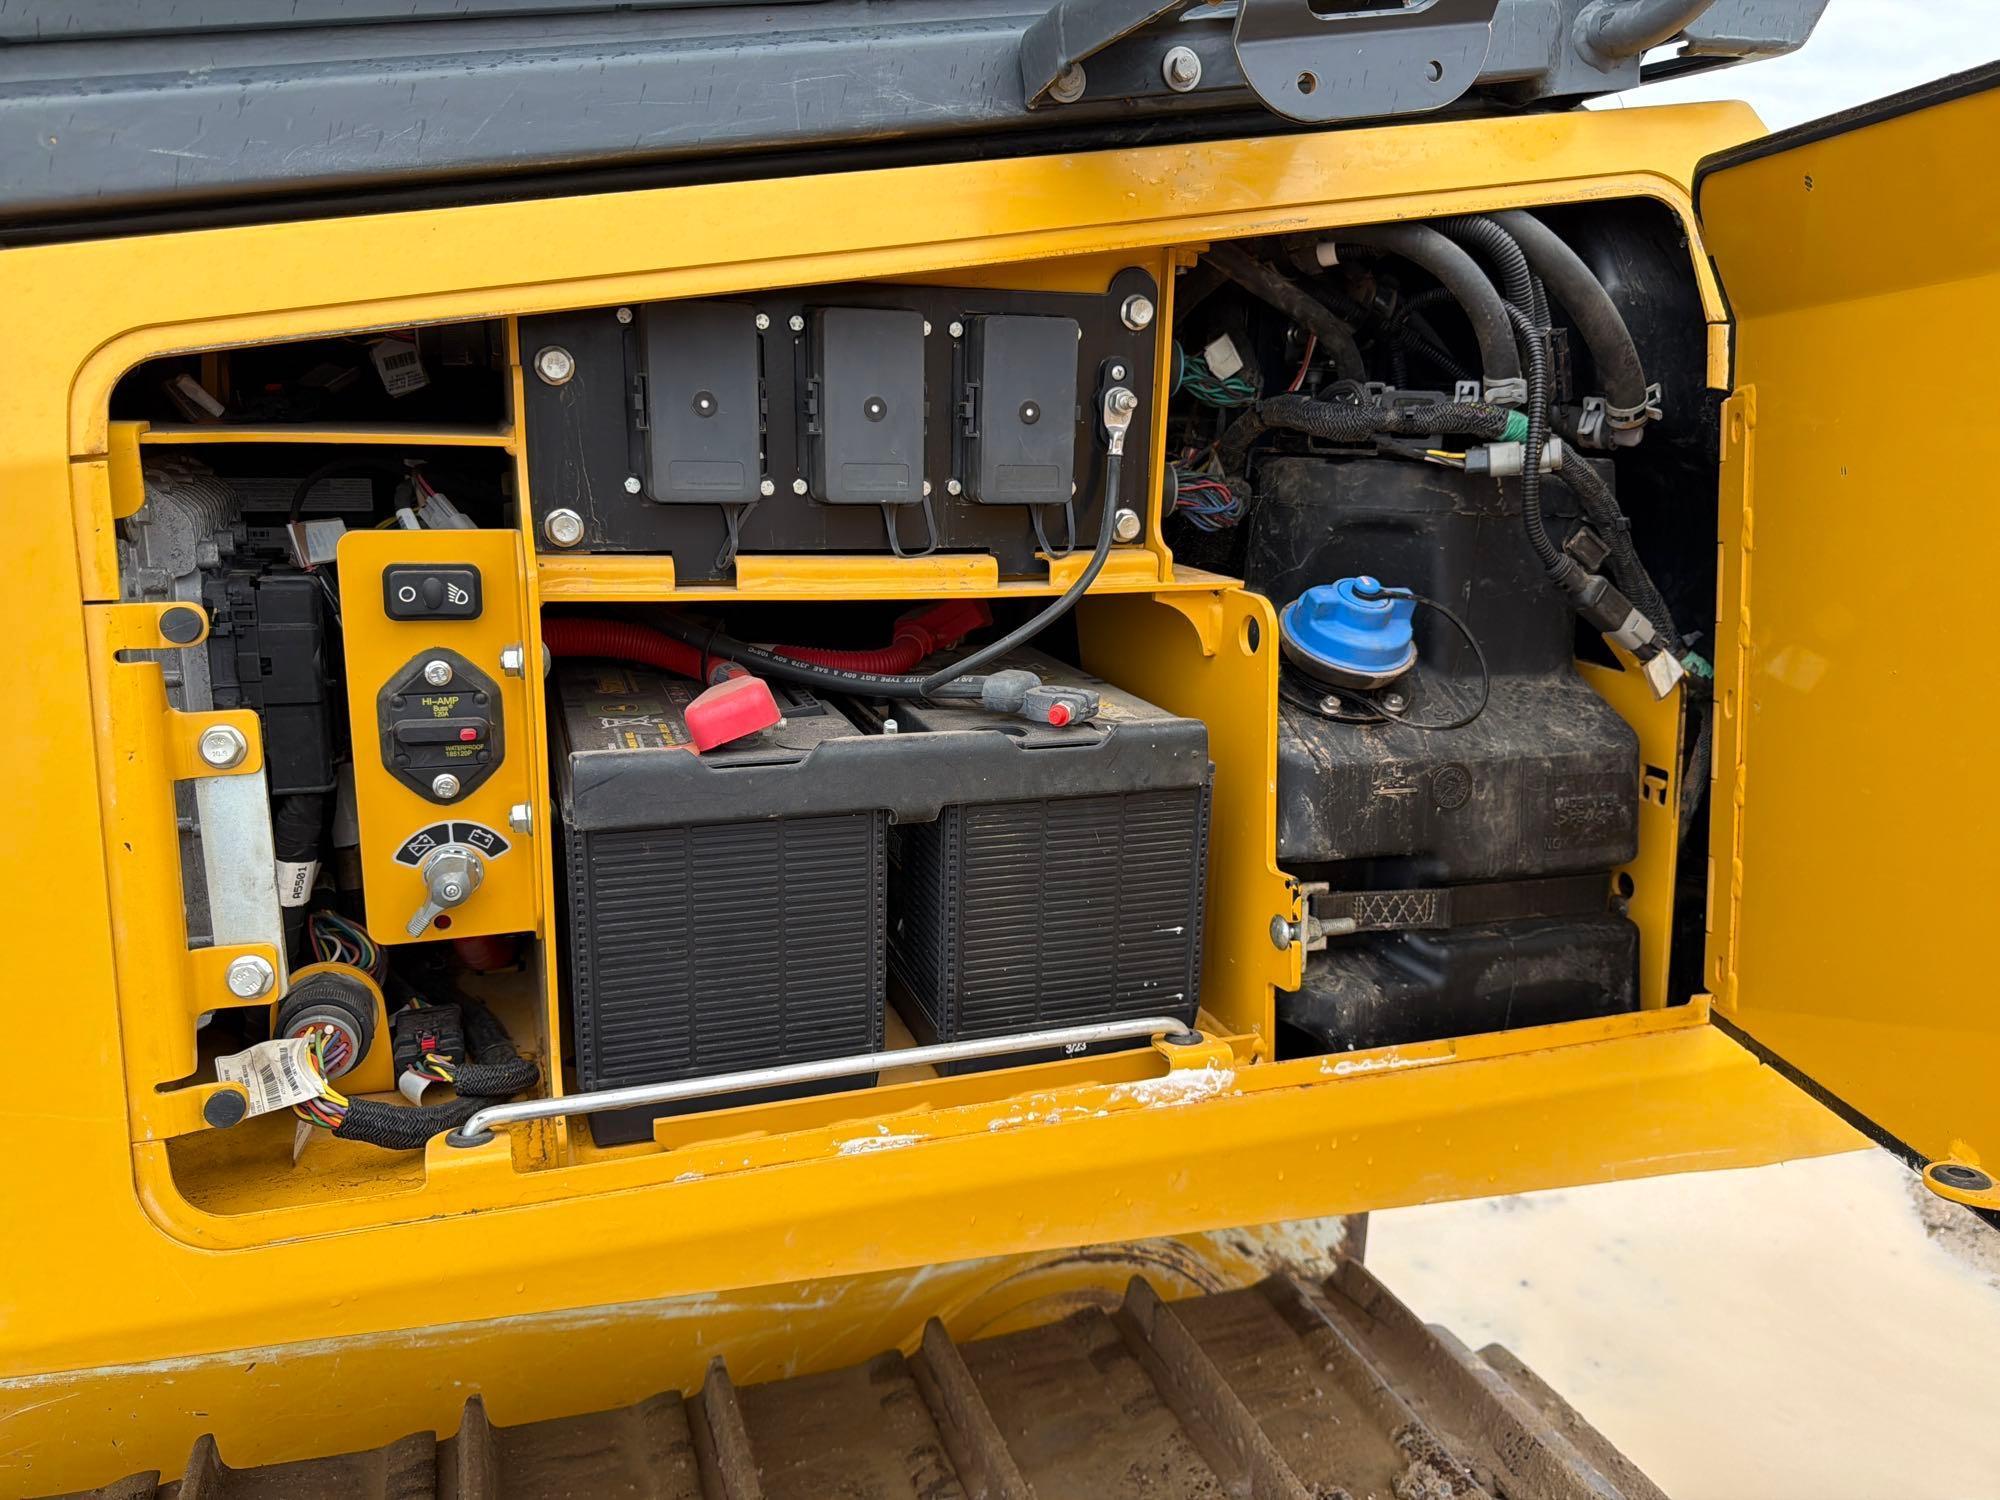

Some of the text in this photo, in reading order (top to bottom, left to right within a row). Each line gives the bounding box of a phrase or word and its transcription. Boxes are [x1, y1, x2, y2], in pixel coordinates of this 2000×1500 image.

[773, 655, 788, 663] 50V
[422, 696, 459, 705] HI-AMP
[292, 865, 308, 899] A5501
[1065, 1042, 1087, 1055] 3/23
